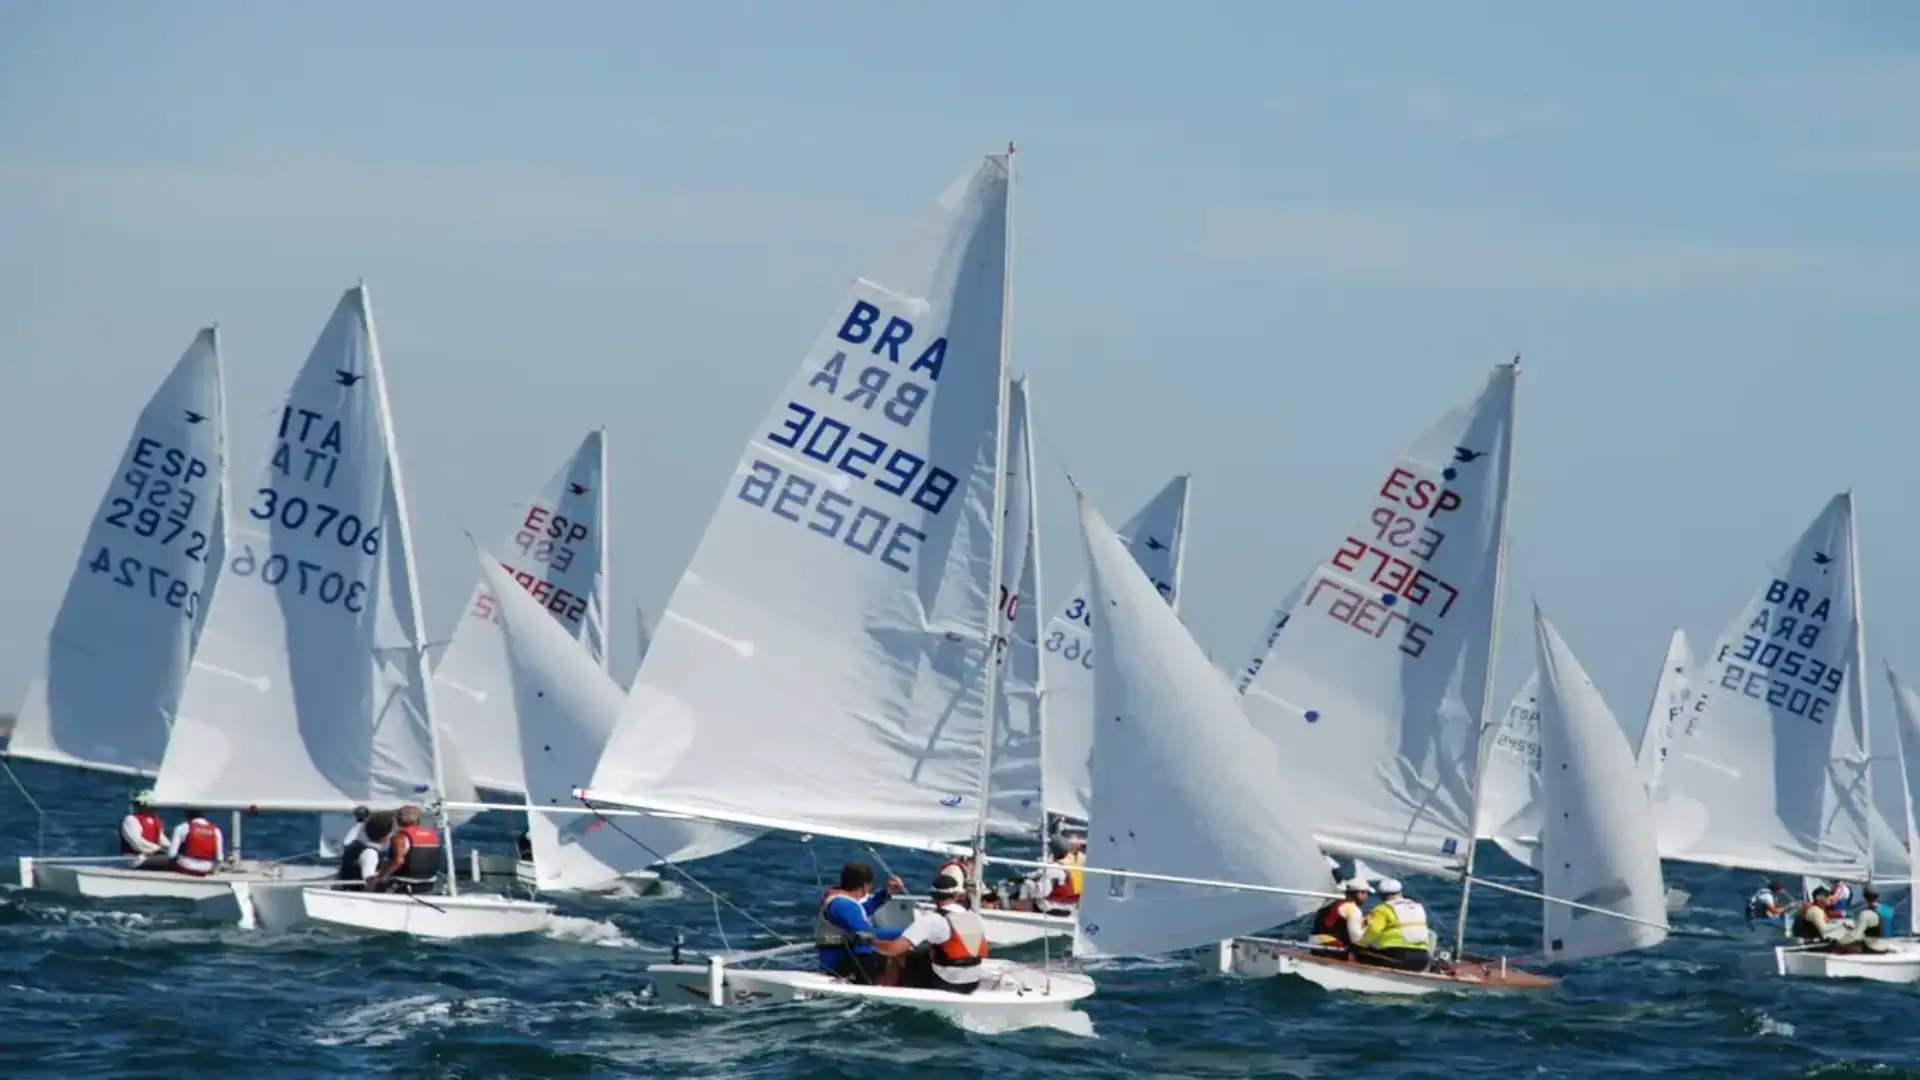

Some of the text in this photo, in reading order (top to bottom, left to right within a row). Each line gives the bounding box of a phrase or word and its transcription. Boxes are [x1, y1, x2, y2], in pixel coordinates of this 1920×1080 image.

[836, 299, 948, 382] BRA
[279, 405, 341, 454] ITA
[132, 437, 207, 484] ESP
[767, 401, 959, 515] 30298
[1380, 467, 1462, 519] ESP
[249, 488, 380, 555] 30706
[524, 506, 588, 545] ESP
[1331, 535, 1459, 618] 27367
[1765, 579, 1831, 622] BRA
[1734, 634, 1842, 694] 30539
